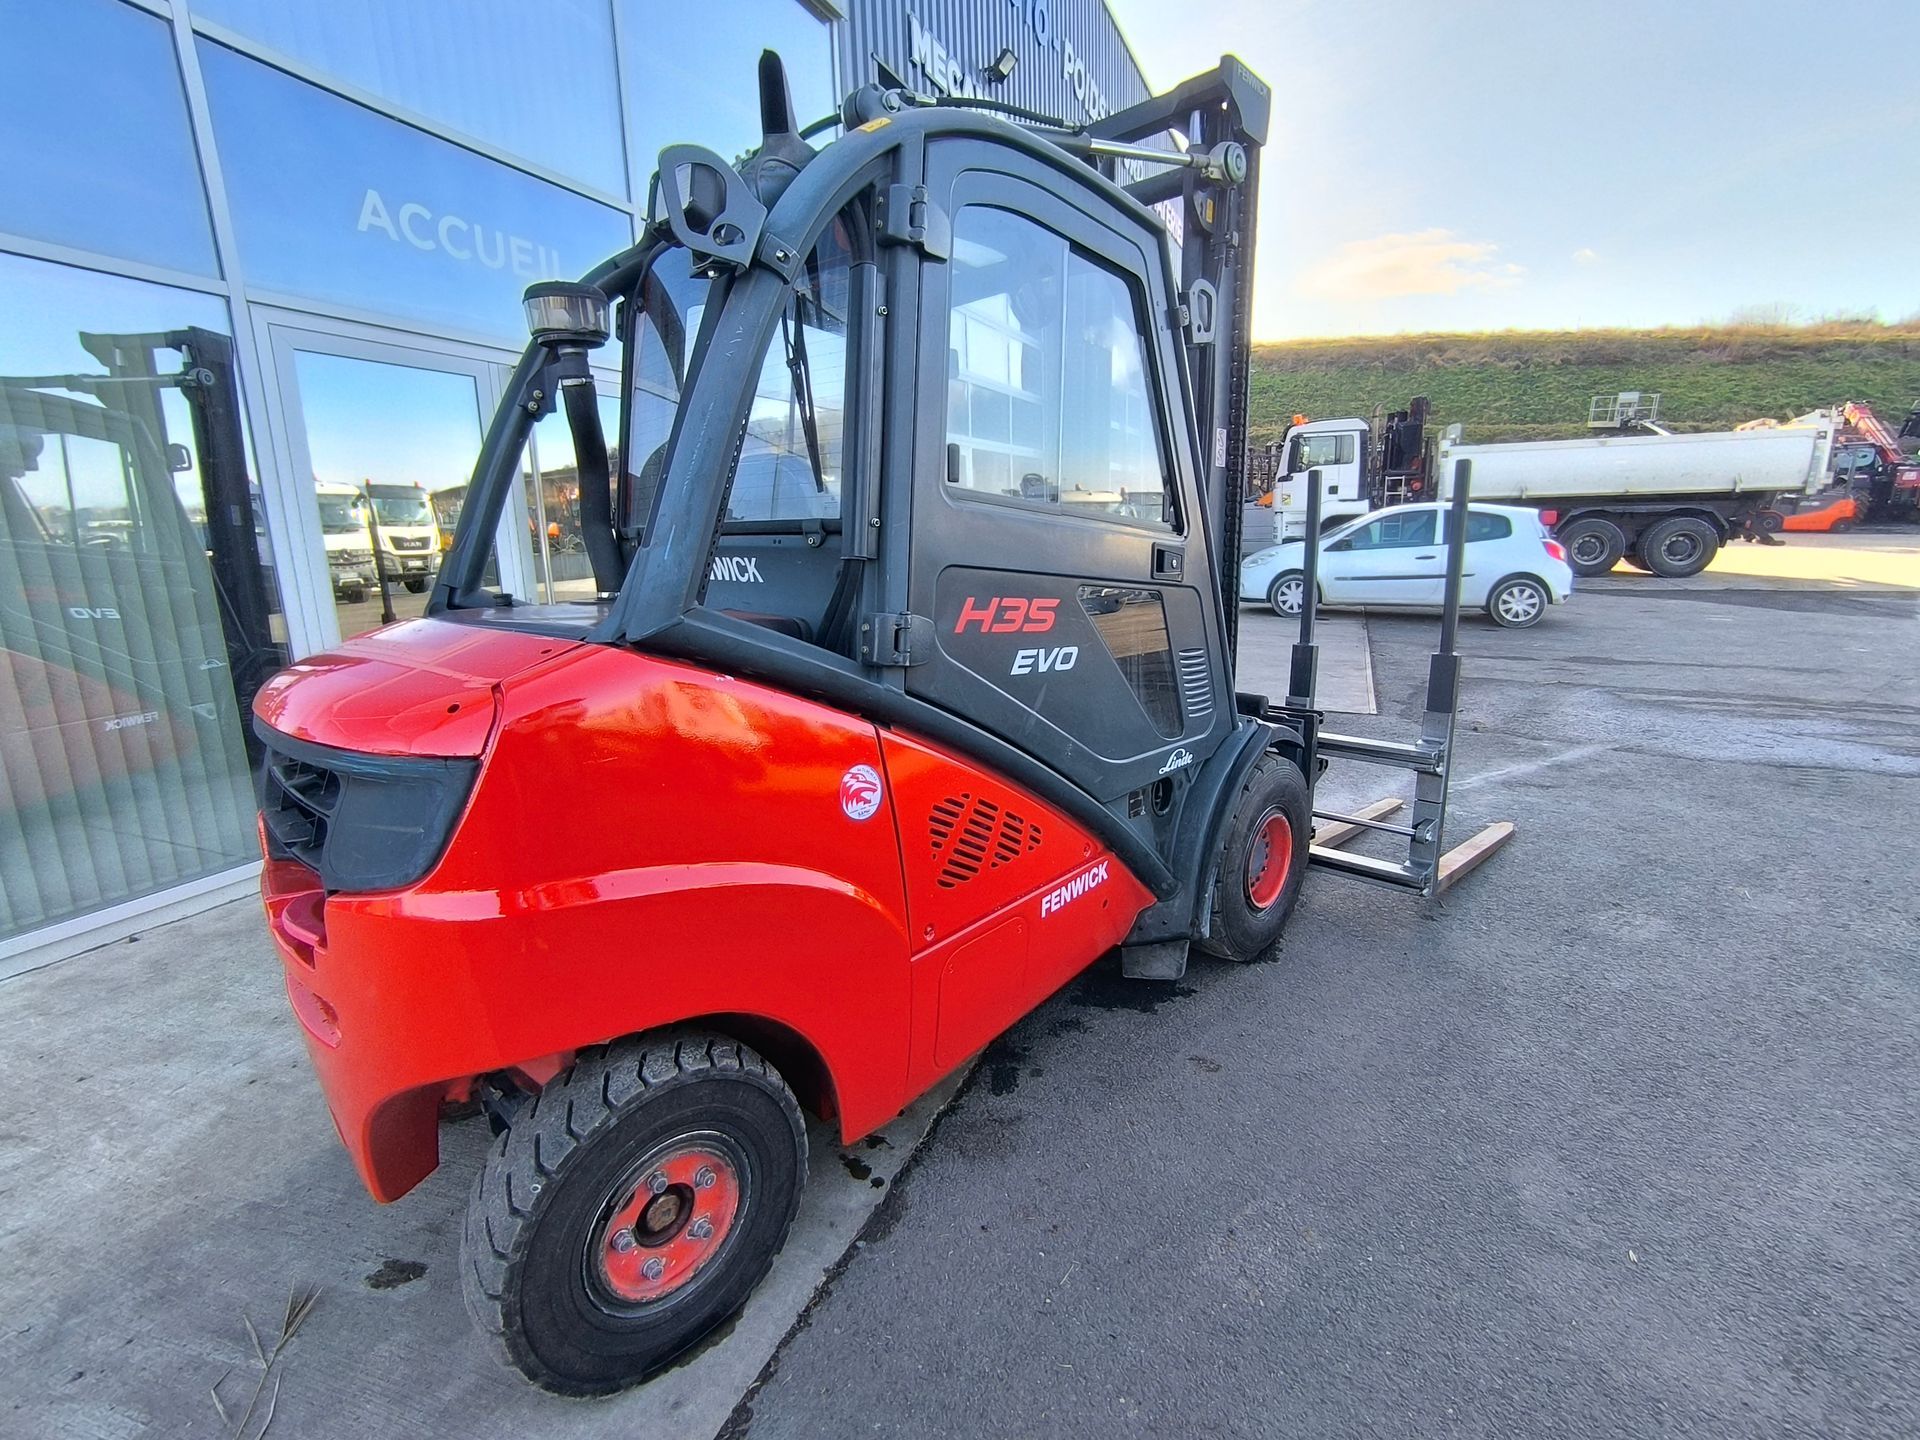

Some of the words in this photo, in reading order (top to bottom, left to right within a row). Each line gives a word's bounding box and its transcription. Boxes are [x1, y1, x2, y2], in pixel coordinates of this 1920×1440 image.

[953, 596, 1061, 633] H35
[1010, 646, 1079, 676] EVO
[1158, 748, 1194, 775] Linde
[1041, 860, 1109, 919] FENWICK
